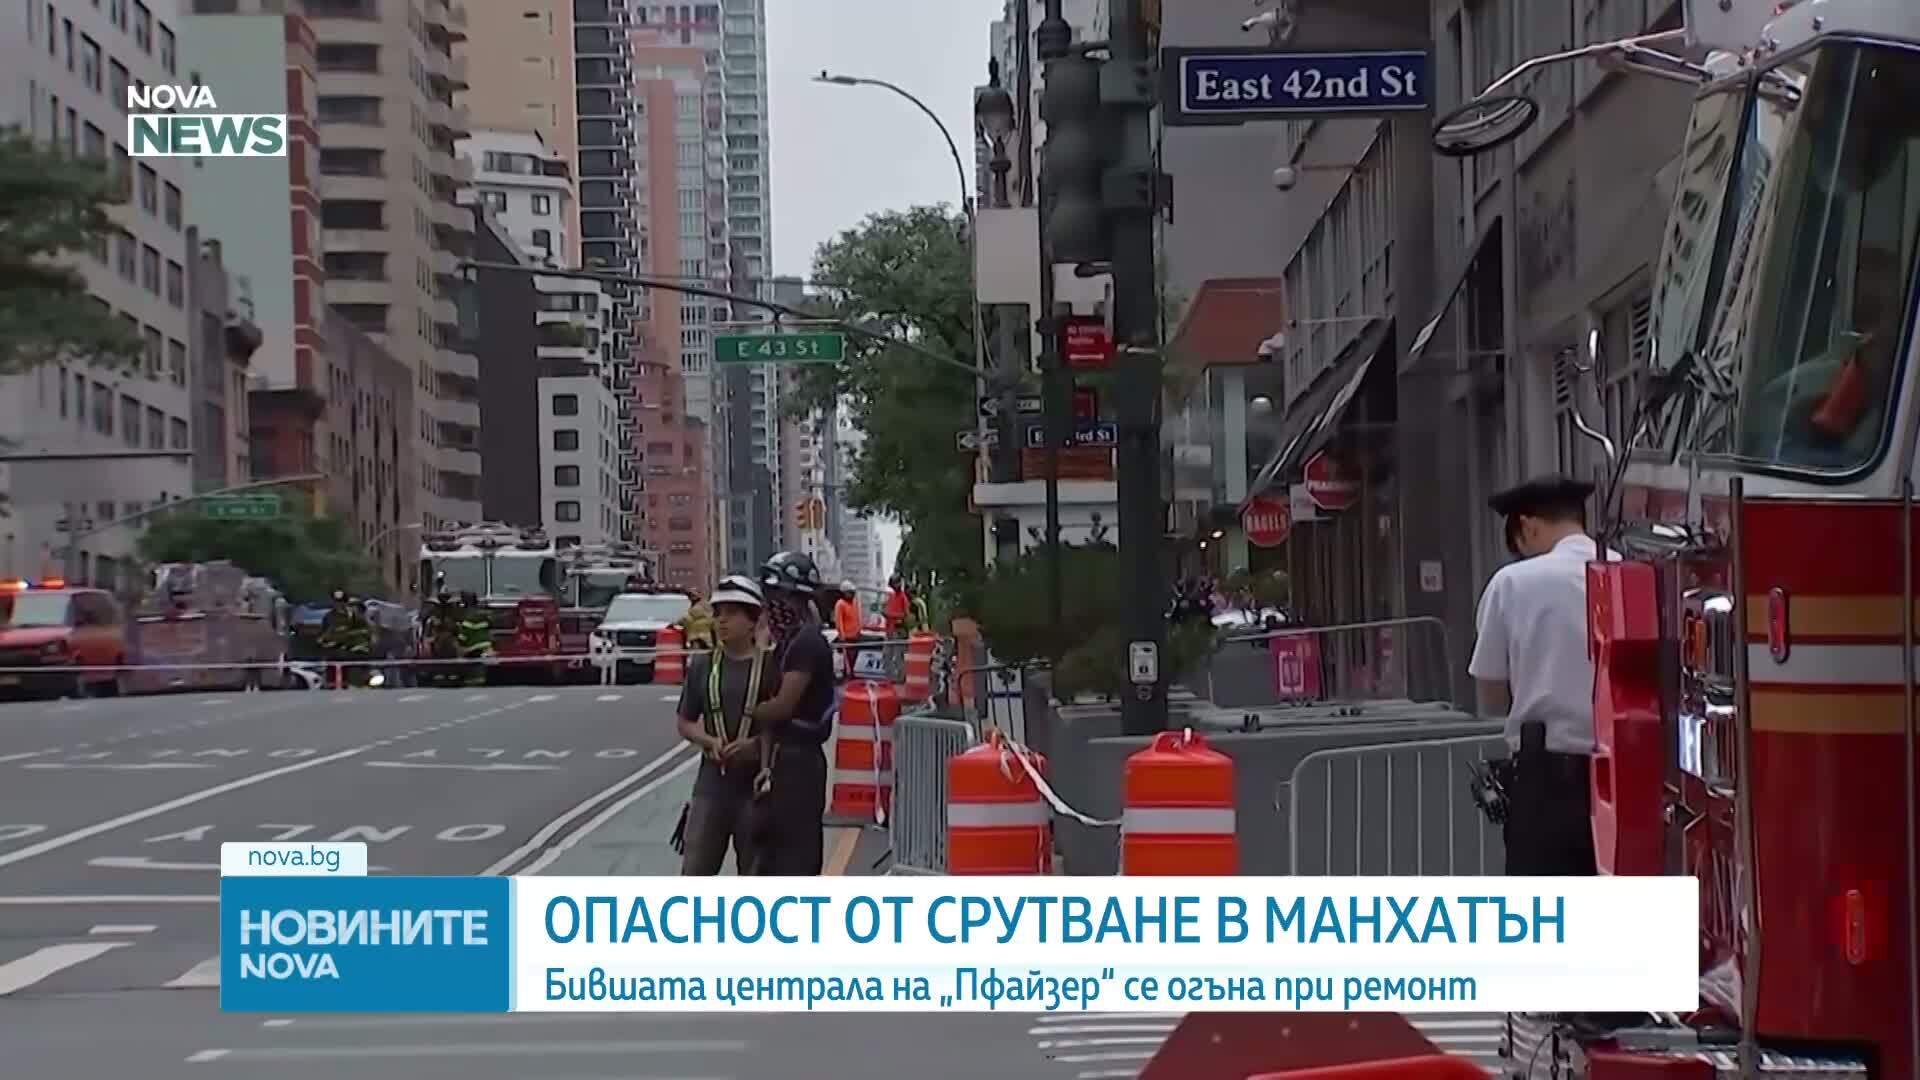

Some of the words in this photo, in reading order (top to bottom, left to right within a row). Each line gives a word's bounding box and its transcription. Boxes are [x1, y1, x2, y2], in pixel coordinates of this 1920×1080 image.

[1195, 70, 1273, 100] East
[1283, 67, 1369, 99] 42nd
[1381, 65, 1417, 96] St
[737, 341, 749, 358] E
[757, 340, 787, 357] 43
[795, 340, 819, 355] St
[1097, 428, 1111, 441] St
[144, 823, 508, 843] ONLY
